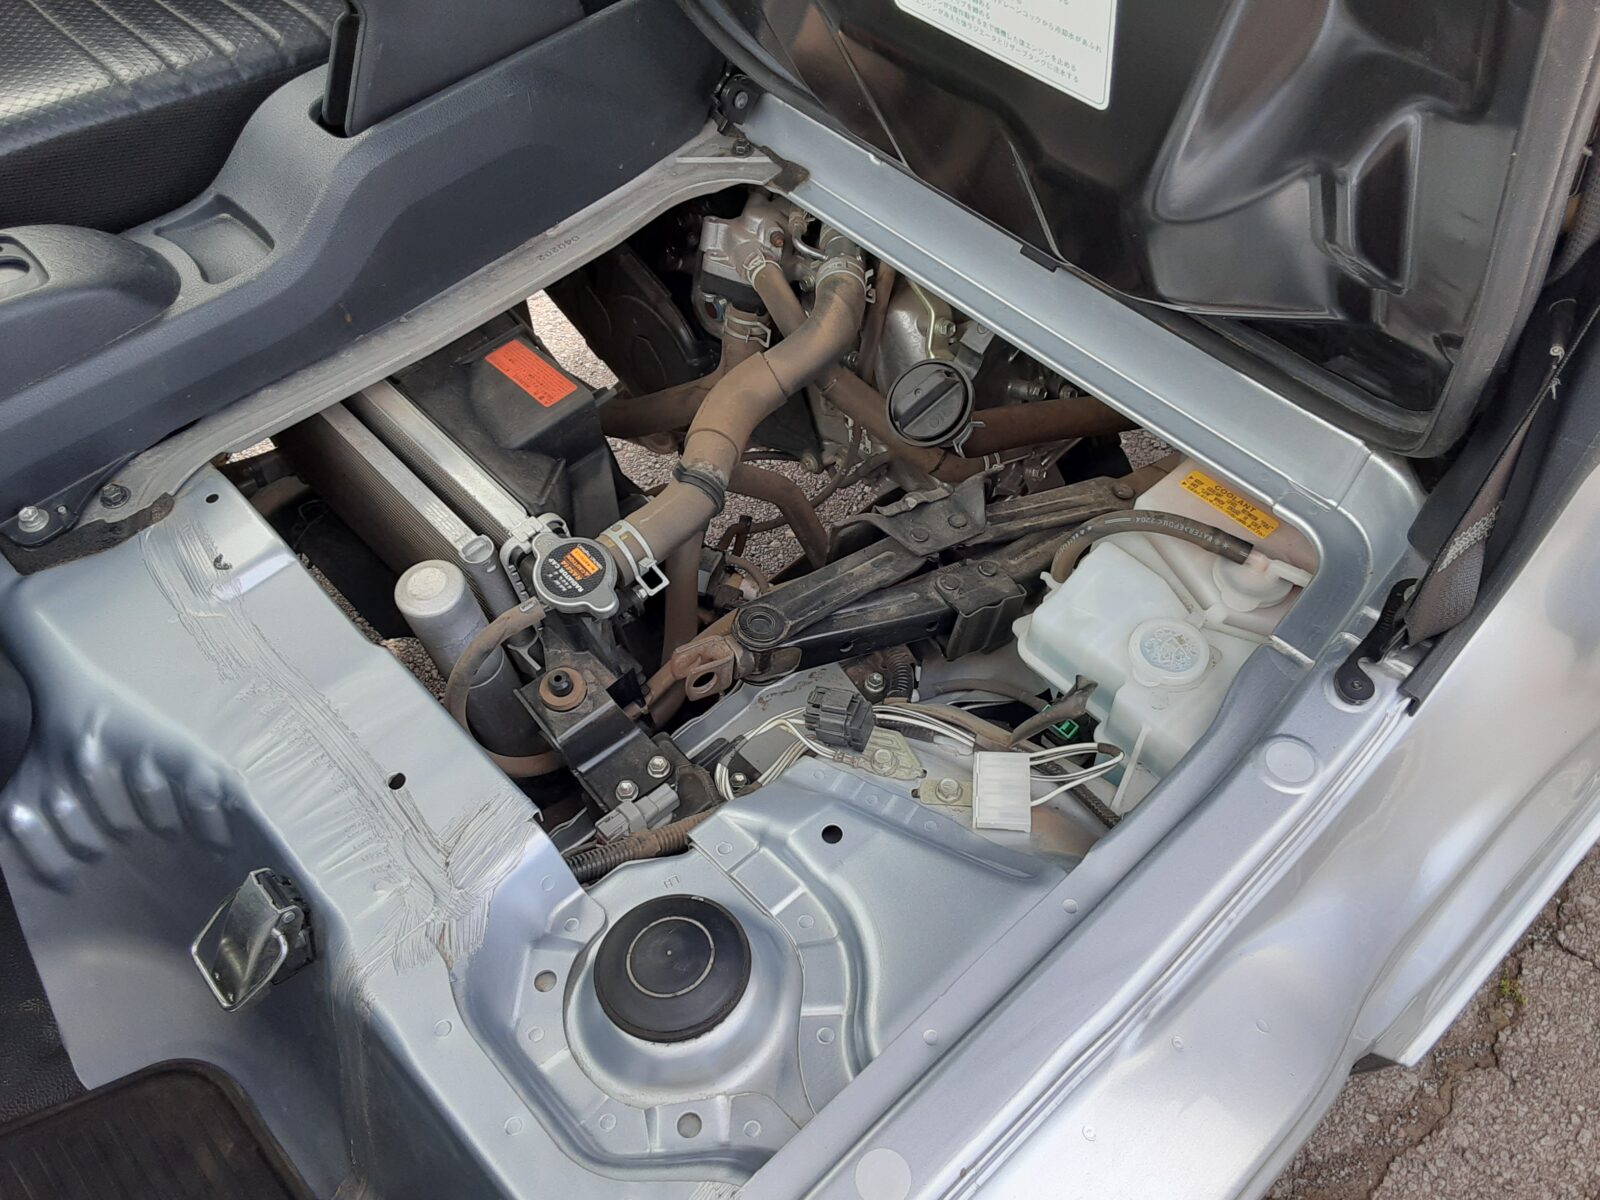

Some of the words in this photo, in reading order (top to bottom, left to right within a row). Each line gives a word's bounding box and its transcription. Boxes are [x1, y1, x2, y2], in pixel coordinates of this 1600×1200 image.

[1214, 484, 1257, 513] COOLANT
[548, 558, 561, 570] CAP
[559, 567, 584, 593] RADIATOR
